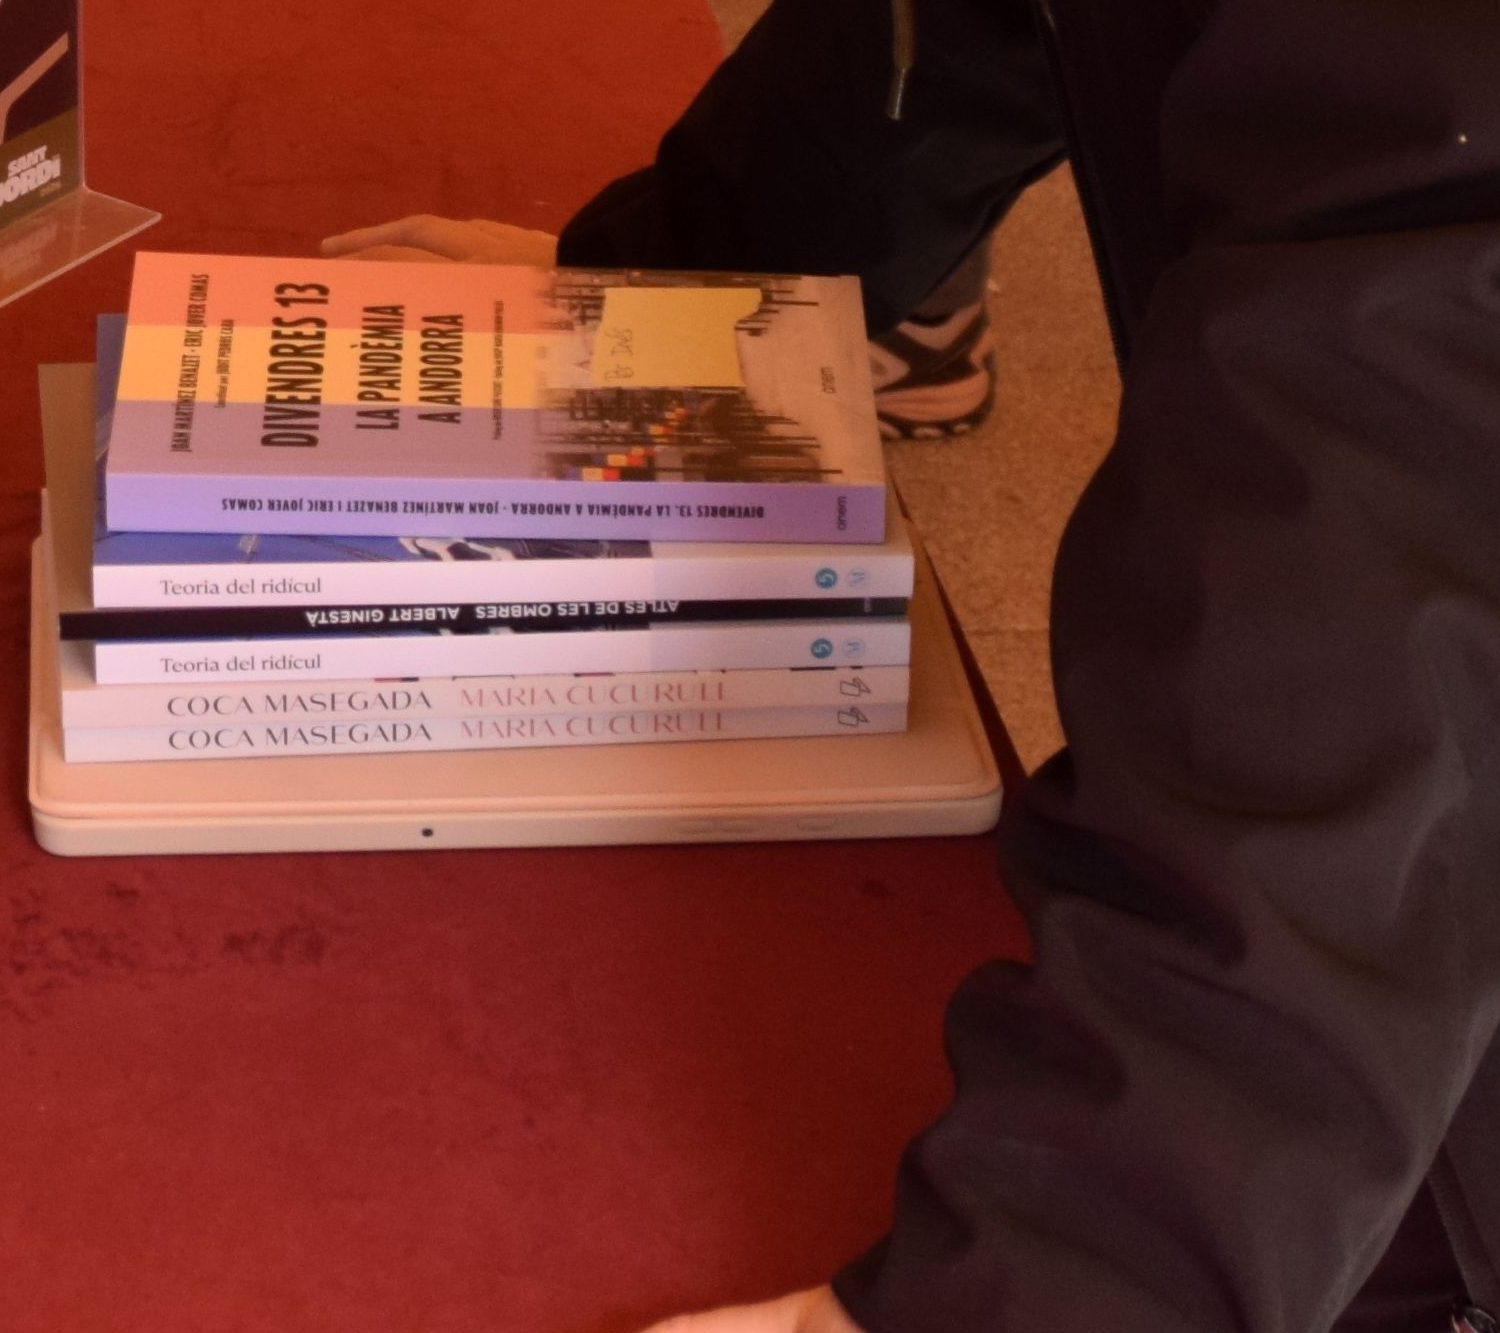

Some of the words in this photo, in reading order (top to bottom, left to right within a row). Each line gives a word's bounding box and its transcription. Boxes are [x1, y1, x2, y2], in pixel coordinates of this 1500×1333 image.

[7, 145, 48, 179] SANT
[189, 273, 209, 302] COMAS
[274, 282, 330, 308] 13
[186, 304, 207, 328] JOVER
[184, 330, 204, 347] ERIC
[350, 305, 405, 403] PANDÈMIA
[418, 314, 464, 406] ANDORRA
[260, 316, 329, 448] DIVENDRES
[355, 409, 400, 431] LA
[418, 412, 461, 425] A
[221, 497, 263, 511] COMAS
[266, 497, 303, 512] JOVER
[306, 498, 333, 512] ERIC
[345, 499, 398, 513] BENAZET
[467, 500, 499, 514] JOAN
[510, 502, 571, 516] ANDORRA
[574, 502, 583, 516] A
[654, 503, 671, 517] LA
[695, 503, 765, 519] DIVENDRES
[159, 578, 220, 596] Teoria
[225, 577, 255, 595] del
[261, 577, 322, 594] ridícul
[389, 606, 459, 622] ALBERT
[475, 604, 551, 619] OMBRES
[557, 602, 590, 616] LES
[594, 602, 618, 615] DE
[624, 599, 679, 614] ATLES
[306, 609, 383, 628] GINESTÀ
[159, 656, 220, 674] Teoria
[225, 655, 255, 672] del
[261, 653, 322, 671] ridícul
[166, 694, 254, 717] COCA
[263, 689, 433, 714] MASEGADA
[459, 686, 557, 708] MARIA
[167, 727, 255, 751] COCA
[264, 721, 433, 747] MASEGADA
[459, 716, 557, 739] MARIA
